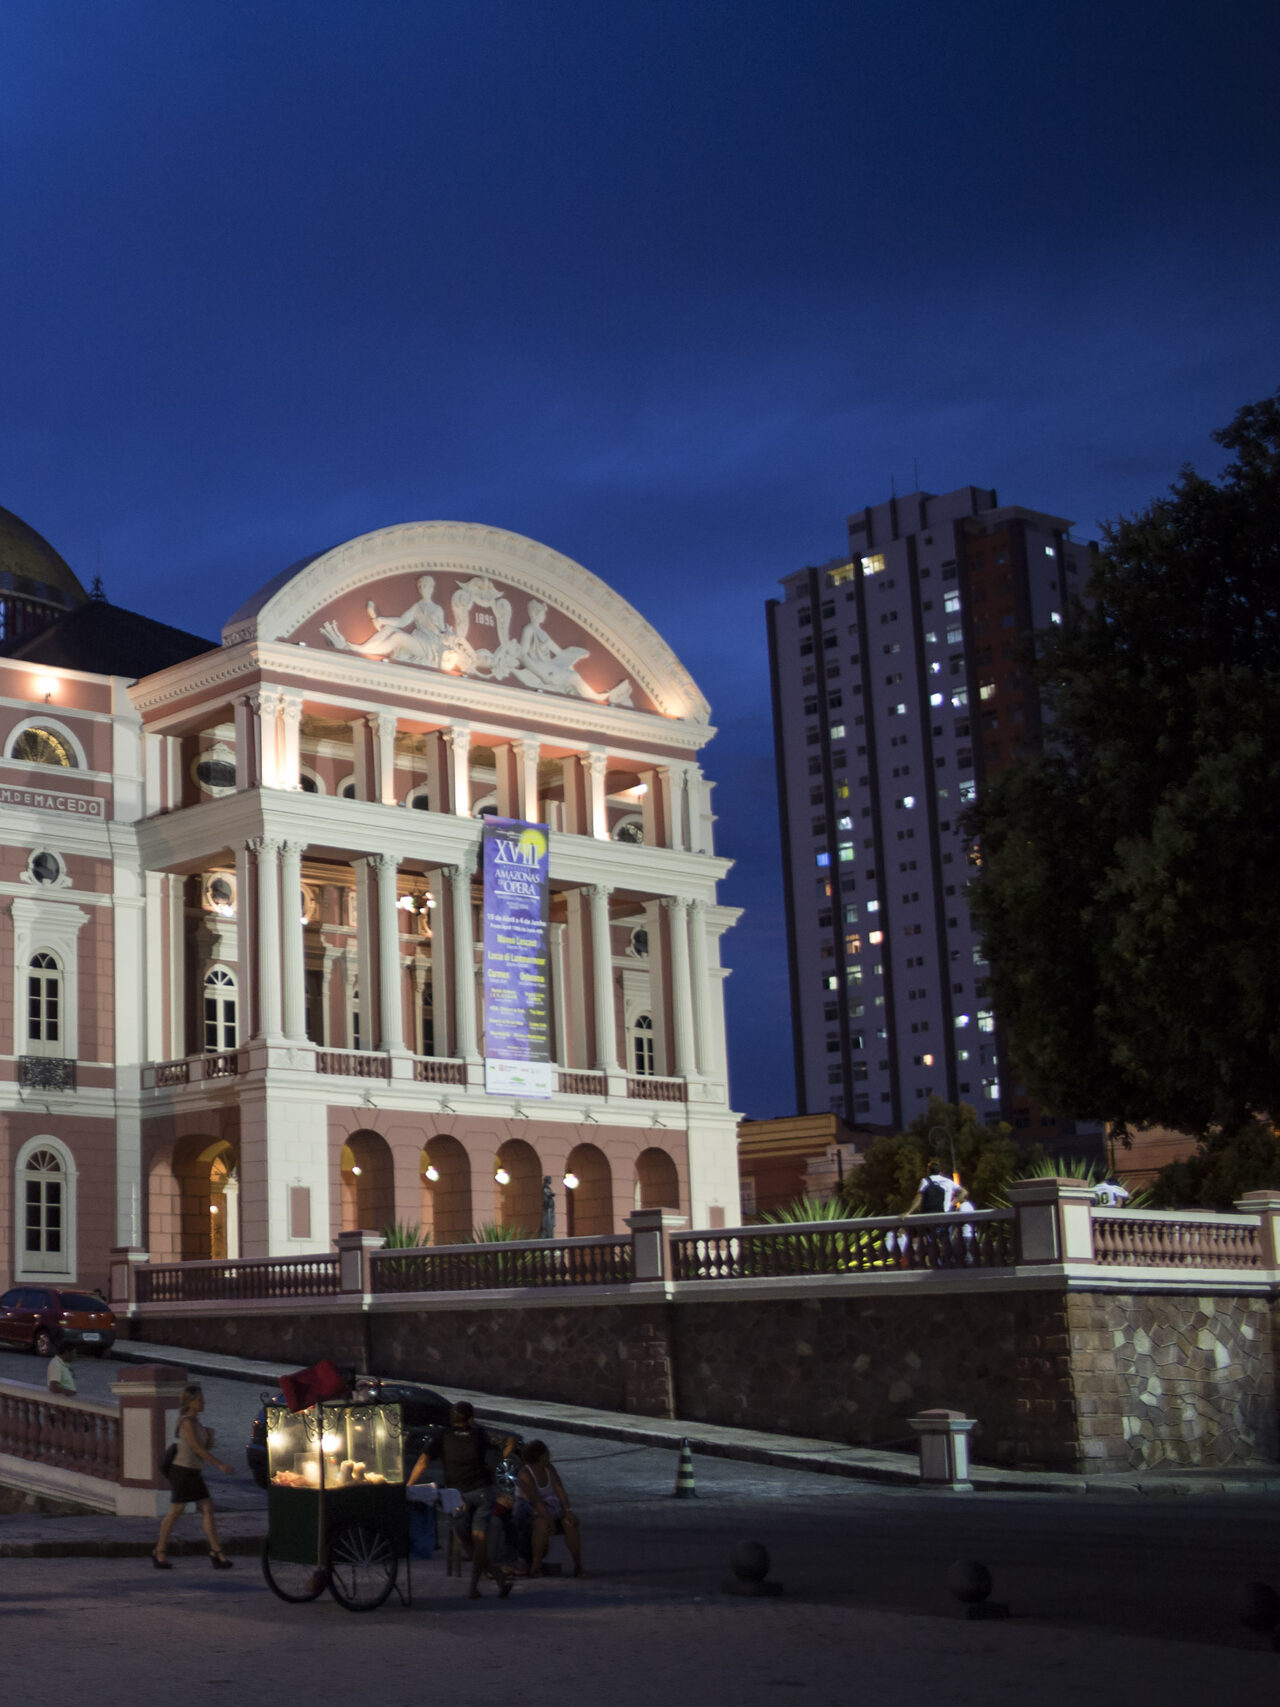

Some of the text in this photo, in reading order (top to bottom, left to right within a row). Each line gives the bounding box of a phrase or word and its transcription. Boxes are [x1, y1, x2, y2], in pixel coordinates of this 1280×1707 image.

[14, 792, 31, 803] DE
[34, 795, 98, 814] MACEDO
[495, 868, 540, 884] AMAZONAS
